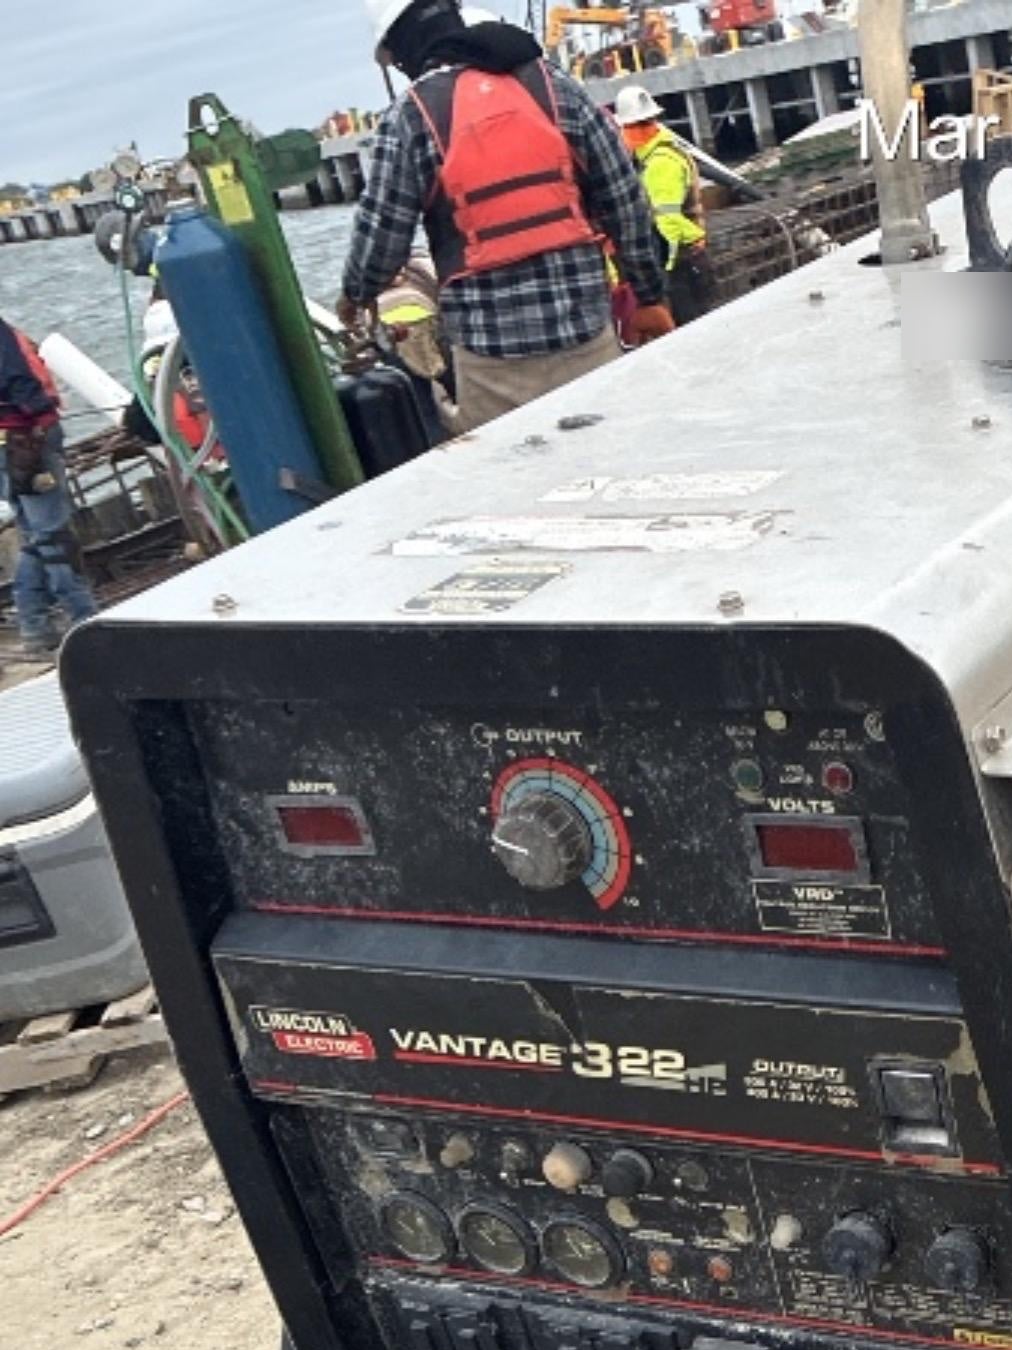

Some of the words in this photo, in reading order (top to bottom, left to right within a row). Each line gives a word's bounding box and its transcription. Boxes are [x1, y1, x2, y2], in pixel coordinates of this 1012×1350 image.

[505, 728, 583, 745] OUTPUT
[767, 797, 835, 815] VOLTS
[255, 1009, 349, 1034] LINCOLN
[284, 1034, 364, 1056] ELECTRIC
[389, 1027, 564, 1067] VANTAGE
[571, 1041, 687, 1080] 322
[752, 1057, 841, 1080] OUTPUT
